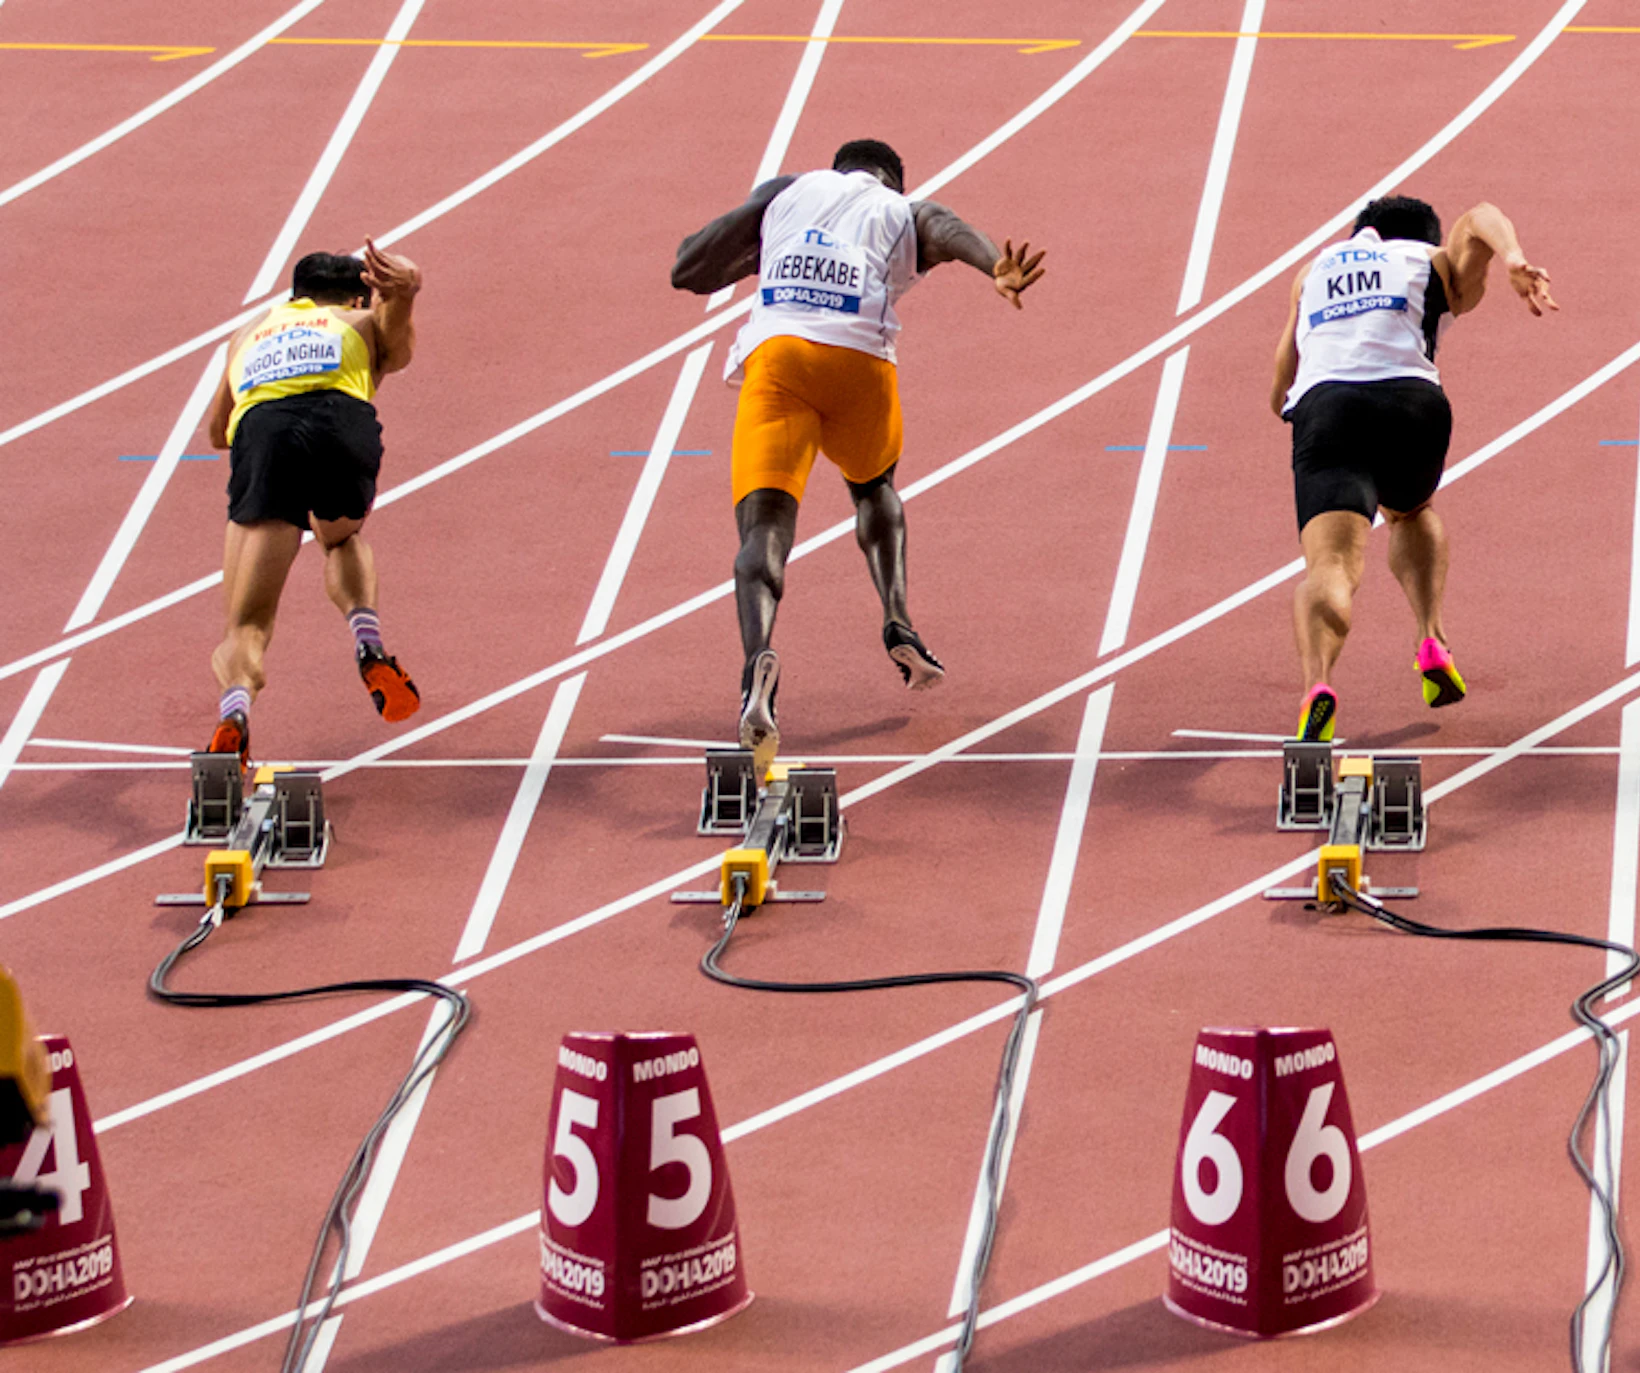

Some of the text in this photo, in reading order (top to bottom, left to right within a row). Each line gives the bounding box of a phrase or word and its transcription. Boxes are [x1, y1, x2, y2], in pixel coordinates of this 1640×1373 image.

[1336, 250, 1389, 264] TDK
[774, 288, 845, 308] DOHA2019
[1327, 270, 1382, 299] KIM
[1322, 298, 1393, 320] DOHA2019
[272, 328, 324, 344] TDK
[244, 344, 336, 377] NGOC NGHIA
[253, 364, 324, 385] DOHA2019
[558, 1044, 608, 1081] MONDO
[633, 1046, 700, 1083] MONDO
[1195, 1043, 1254, 1079] MONDO
[1274, 1042, 1336, 1077] MONDO
[11, 1086, 91, 1225] 4
[548, 1087, 599, 1227] 5
[646, 1086, 712, 1229] 5
[1182, 1089, 1244, 1226] 6
[1284, 1081, 1352, 1223] 6
[13, 1245, 113, 1300] DOHA2019
[641, 1242, 736, 1298] DOHA2019
